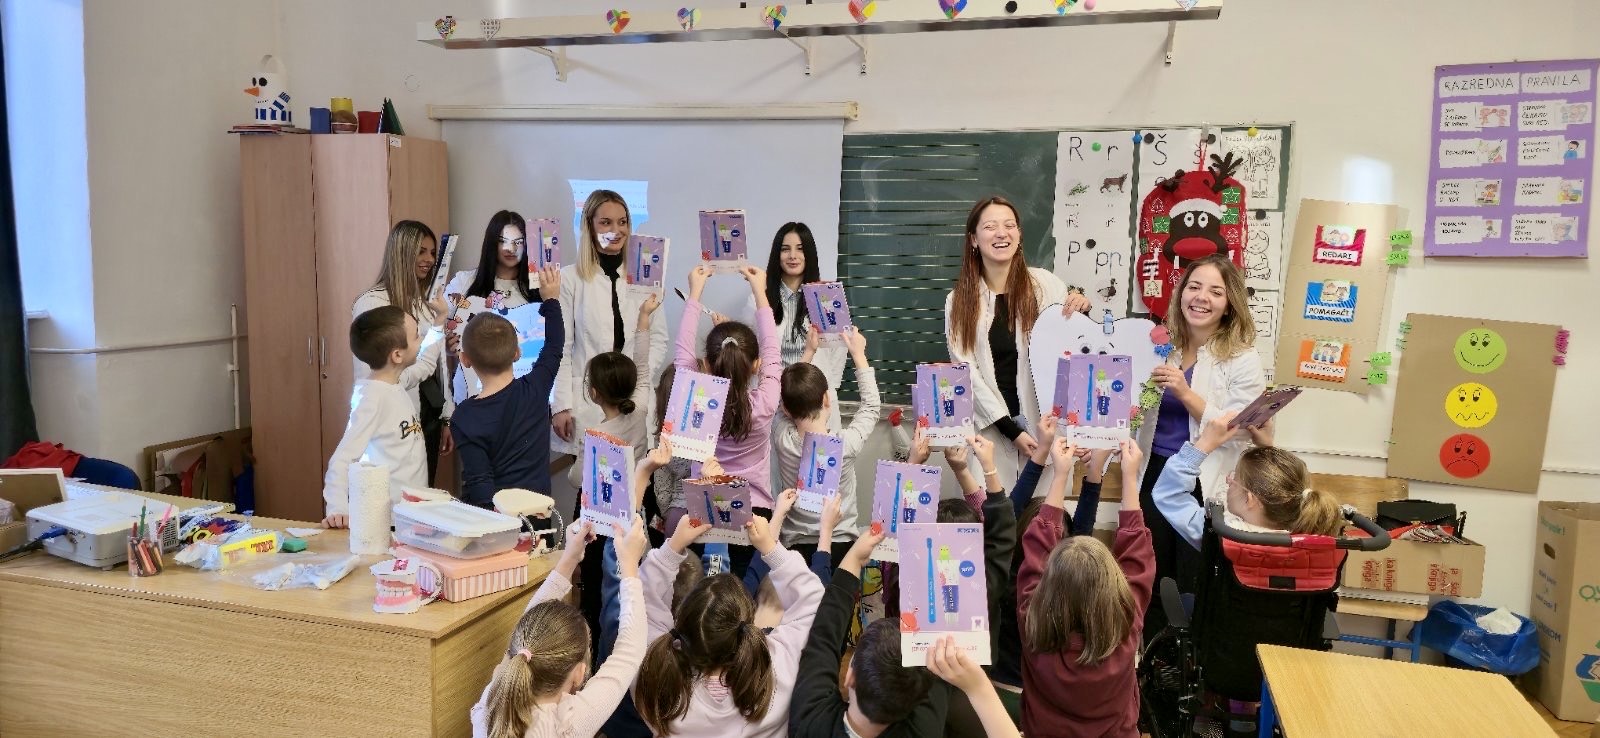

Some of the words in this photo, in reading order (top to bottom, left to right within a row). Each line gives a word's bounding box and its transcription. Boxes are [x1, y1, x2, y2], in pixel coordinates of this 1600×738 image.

[1526, 73, 1582, 88] PRAVILA
[1069, 136, 1084, 162] R
[1107, 145, 1119, 160] r
[1152, 133, 1168, 166] Š
[1067, 240, 1081, 266] P
[1322, 250, 1353, 260] REDARI
[1308, 307, 1350, 317] POMAGAČI
